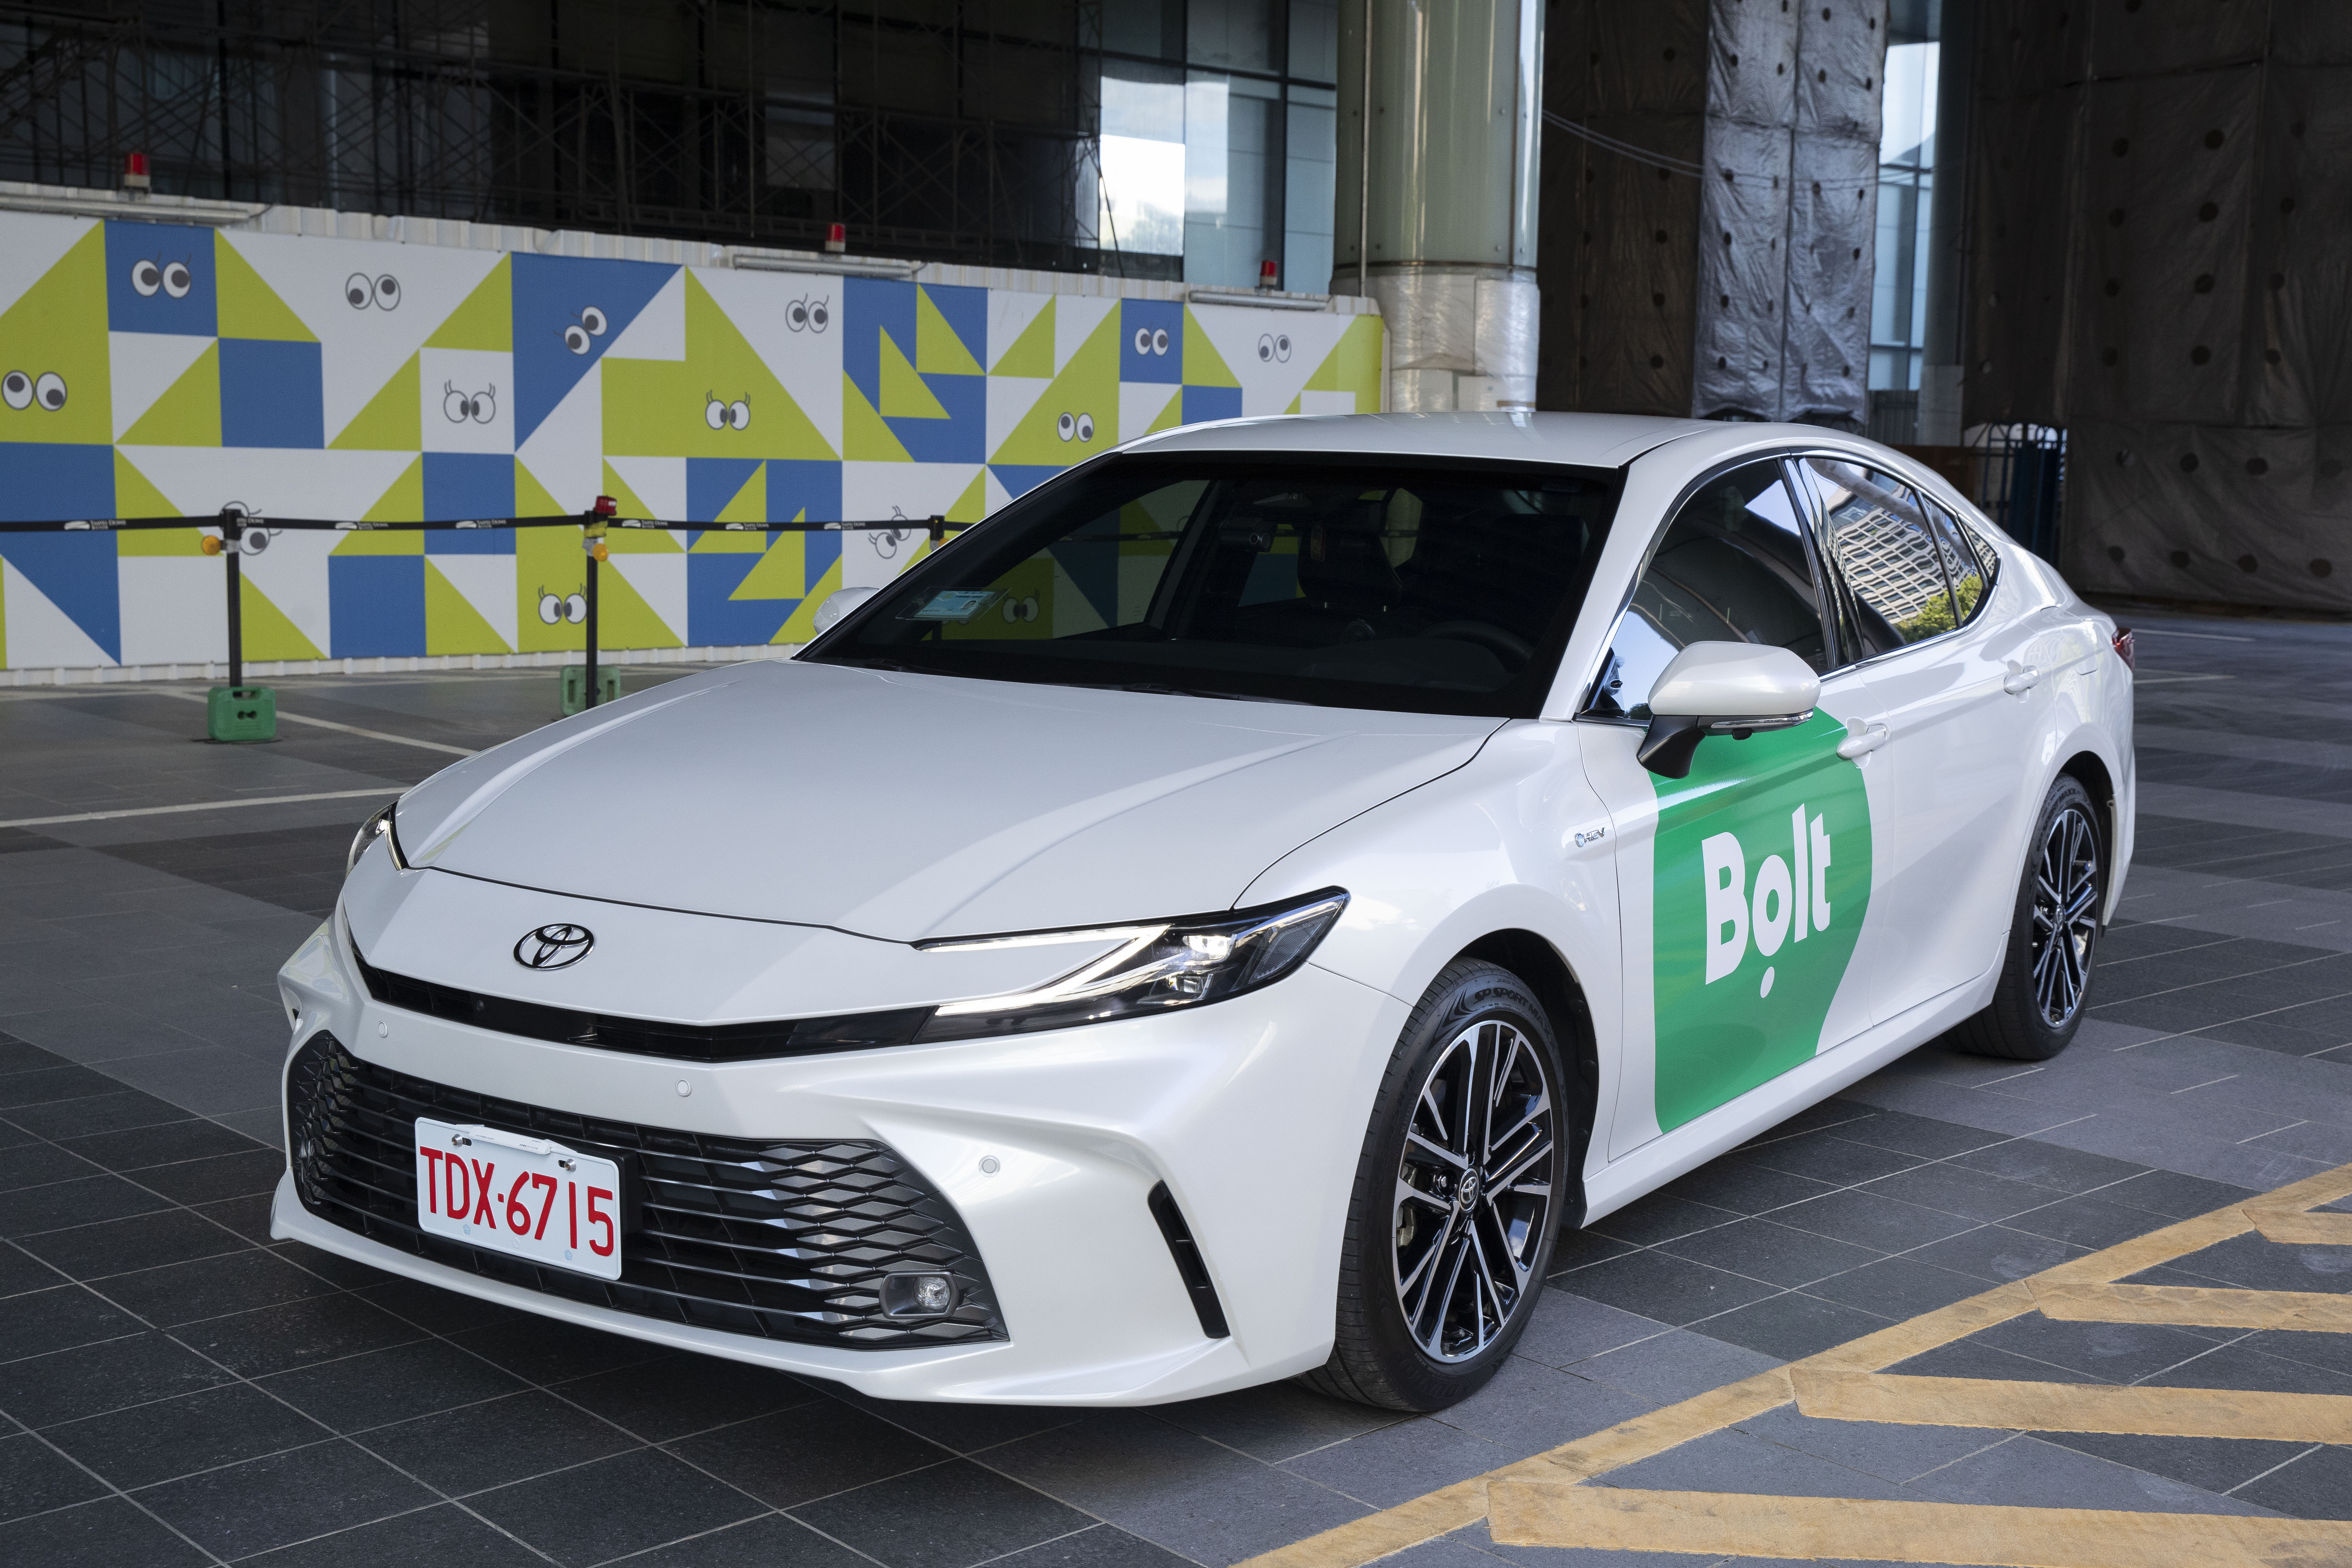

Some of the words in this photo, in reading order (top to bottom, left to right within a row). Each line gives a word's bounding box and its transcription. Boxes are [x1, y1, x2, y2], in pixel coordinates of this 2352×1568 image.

[1583, 827, 1605, 843] HEV
[1701, 803, 1831, 998] Bolt
[1472, 988, 1492, 1005] SP
[1492, 987, 1529, 1007] SPORT
